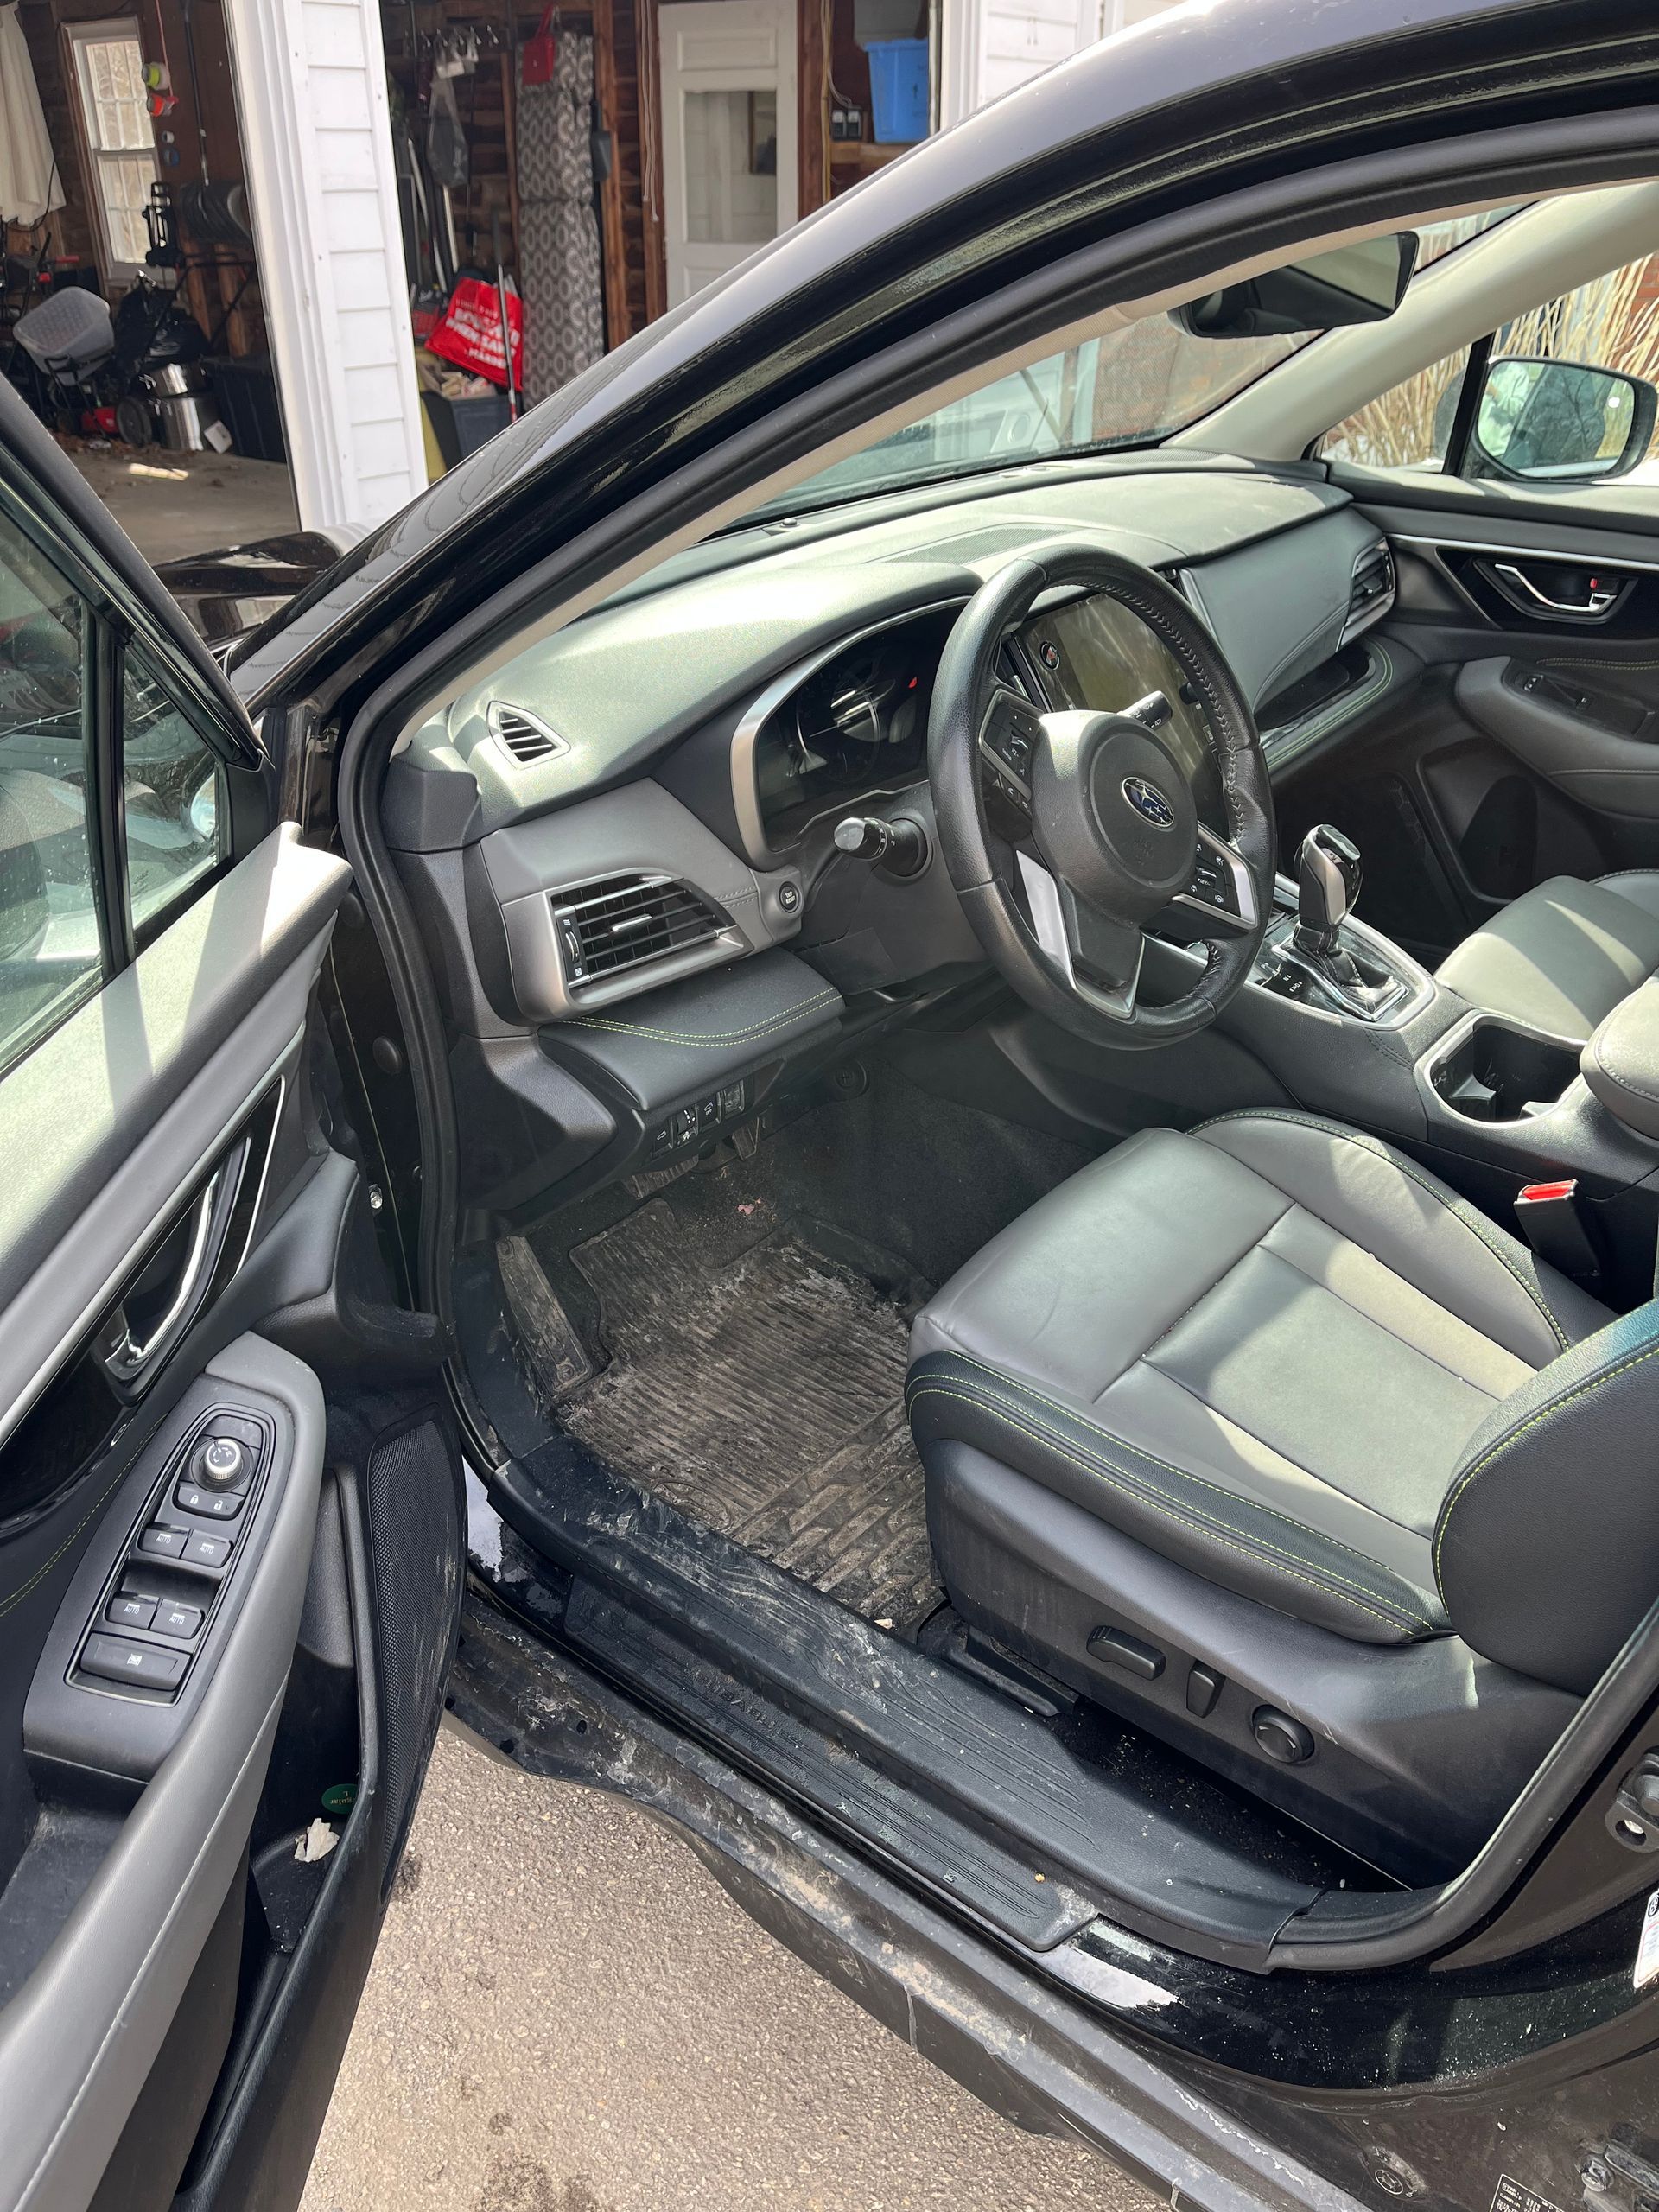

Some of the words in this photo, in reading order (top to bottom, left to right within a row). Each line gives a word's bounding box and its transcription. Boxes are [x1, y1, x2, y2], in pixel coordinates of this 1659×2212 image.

[156, 1535, 172, 1545] AUTO
[199, 1544, 215, 1555] AUTO
[124, 1605, 141, 1615] AUTO
[168, 1615, 185, 1625] AUTO
